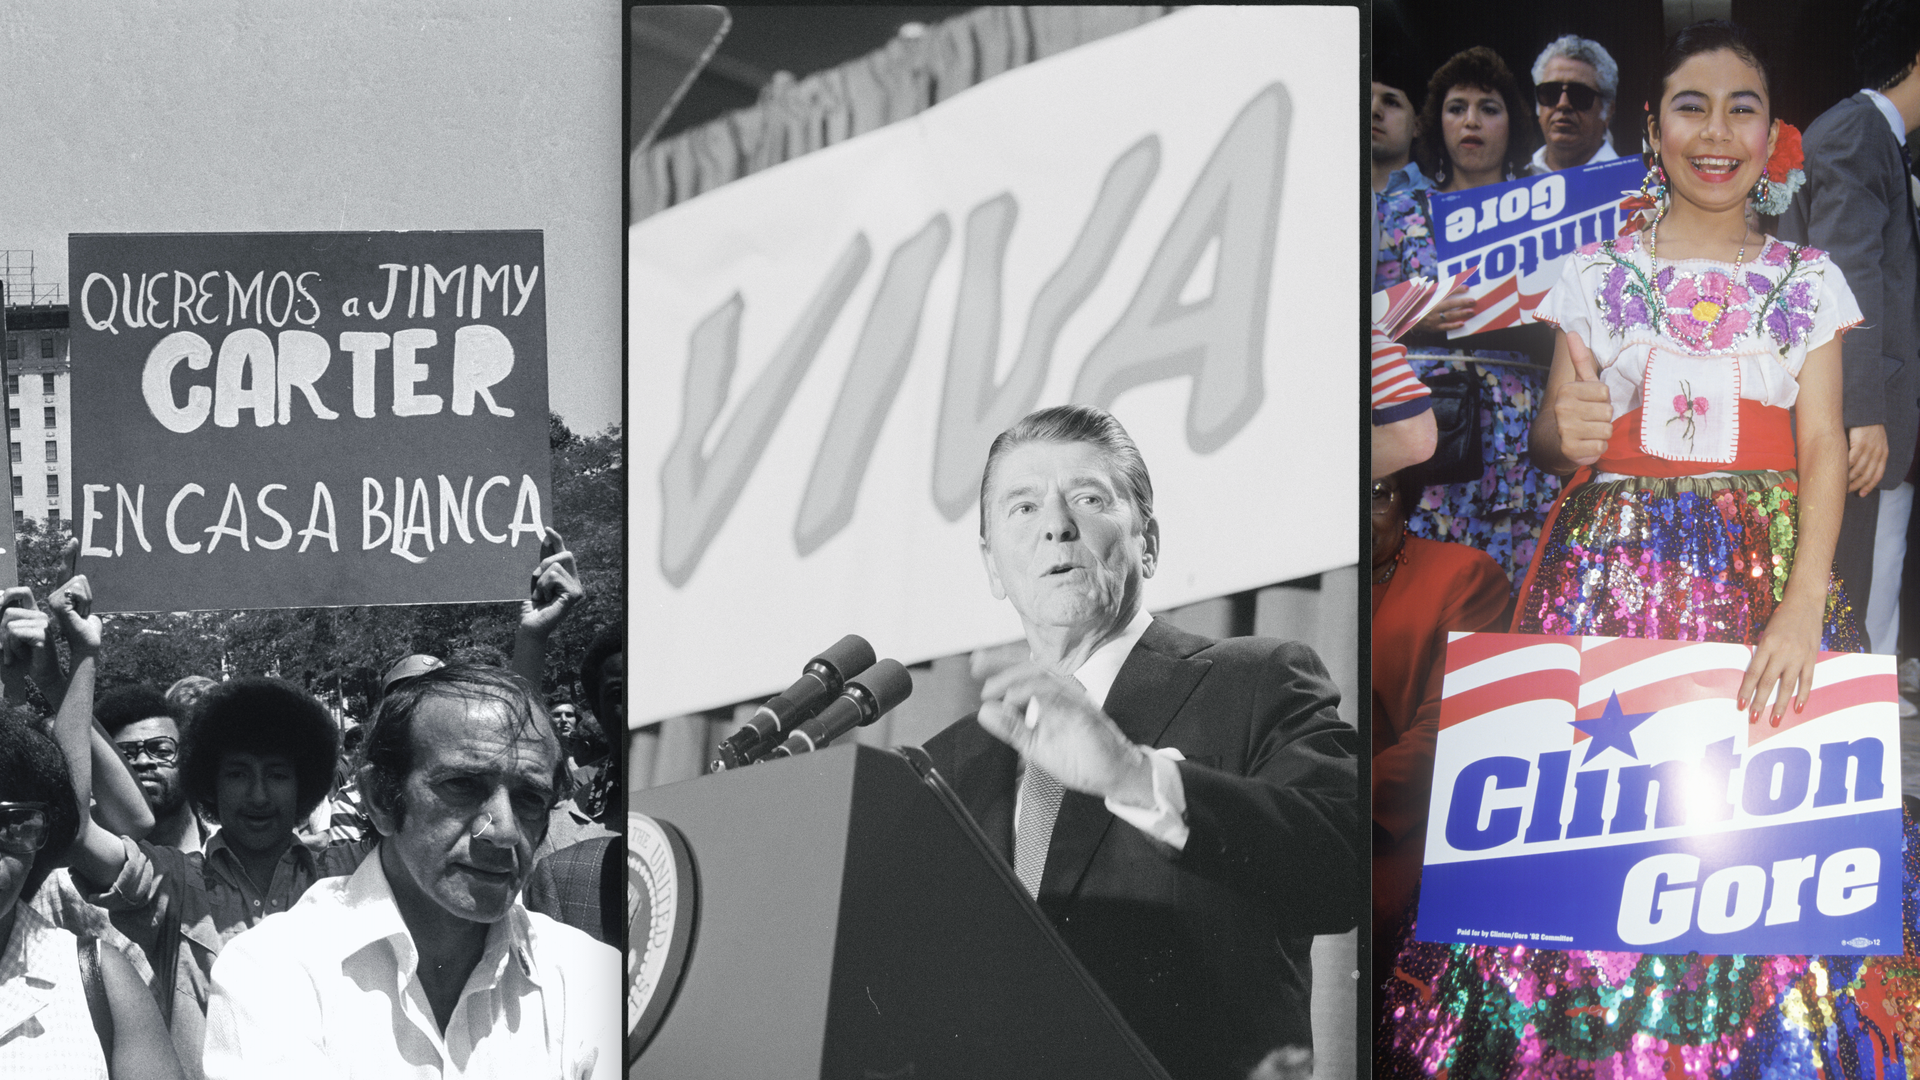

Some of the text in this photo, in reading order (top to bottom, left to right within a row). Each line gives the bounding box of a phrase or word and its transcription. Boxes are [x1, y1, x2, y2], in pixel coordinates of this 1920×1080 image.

[1446, 174, 1566, 242] Gore
[1447, 205, 1632, 289] linton
[81, 264, 539, 334] QUEREMOS a JIMMY
[659, 81, 1292, 589] VIVA
[142, 325, 515, 433] CARTER
[81, 474, 547, 563] EN CASA BLANCA
[1445, 735, 1885, 852] Clinton
[633, 826, 651, 849] THE
[650, 843, 671, 948] UNITED
[1617, 848, 1881, 946] Gore
[1456, 928, 1470, 936] Paid
[1481, 930, 1489, 938] by
[1490, 930, 1528, 939] Clinton/Gore
[1540, 934, 1574, 942] Committee
